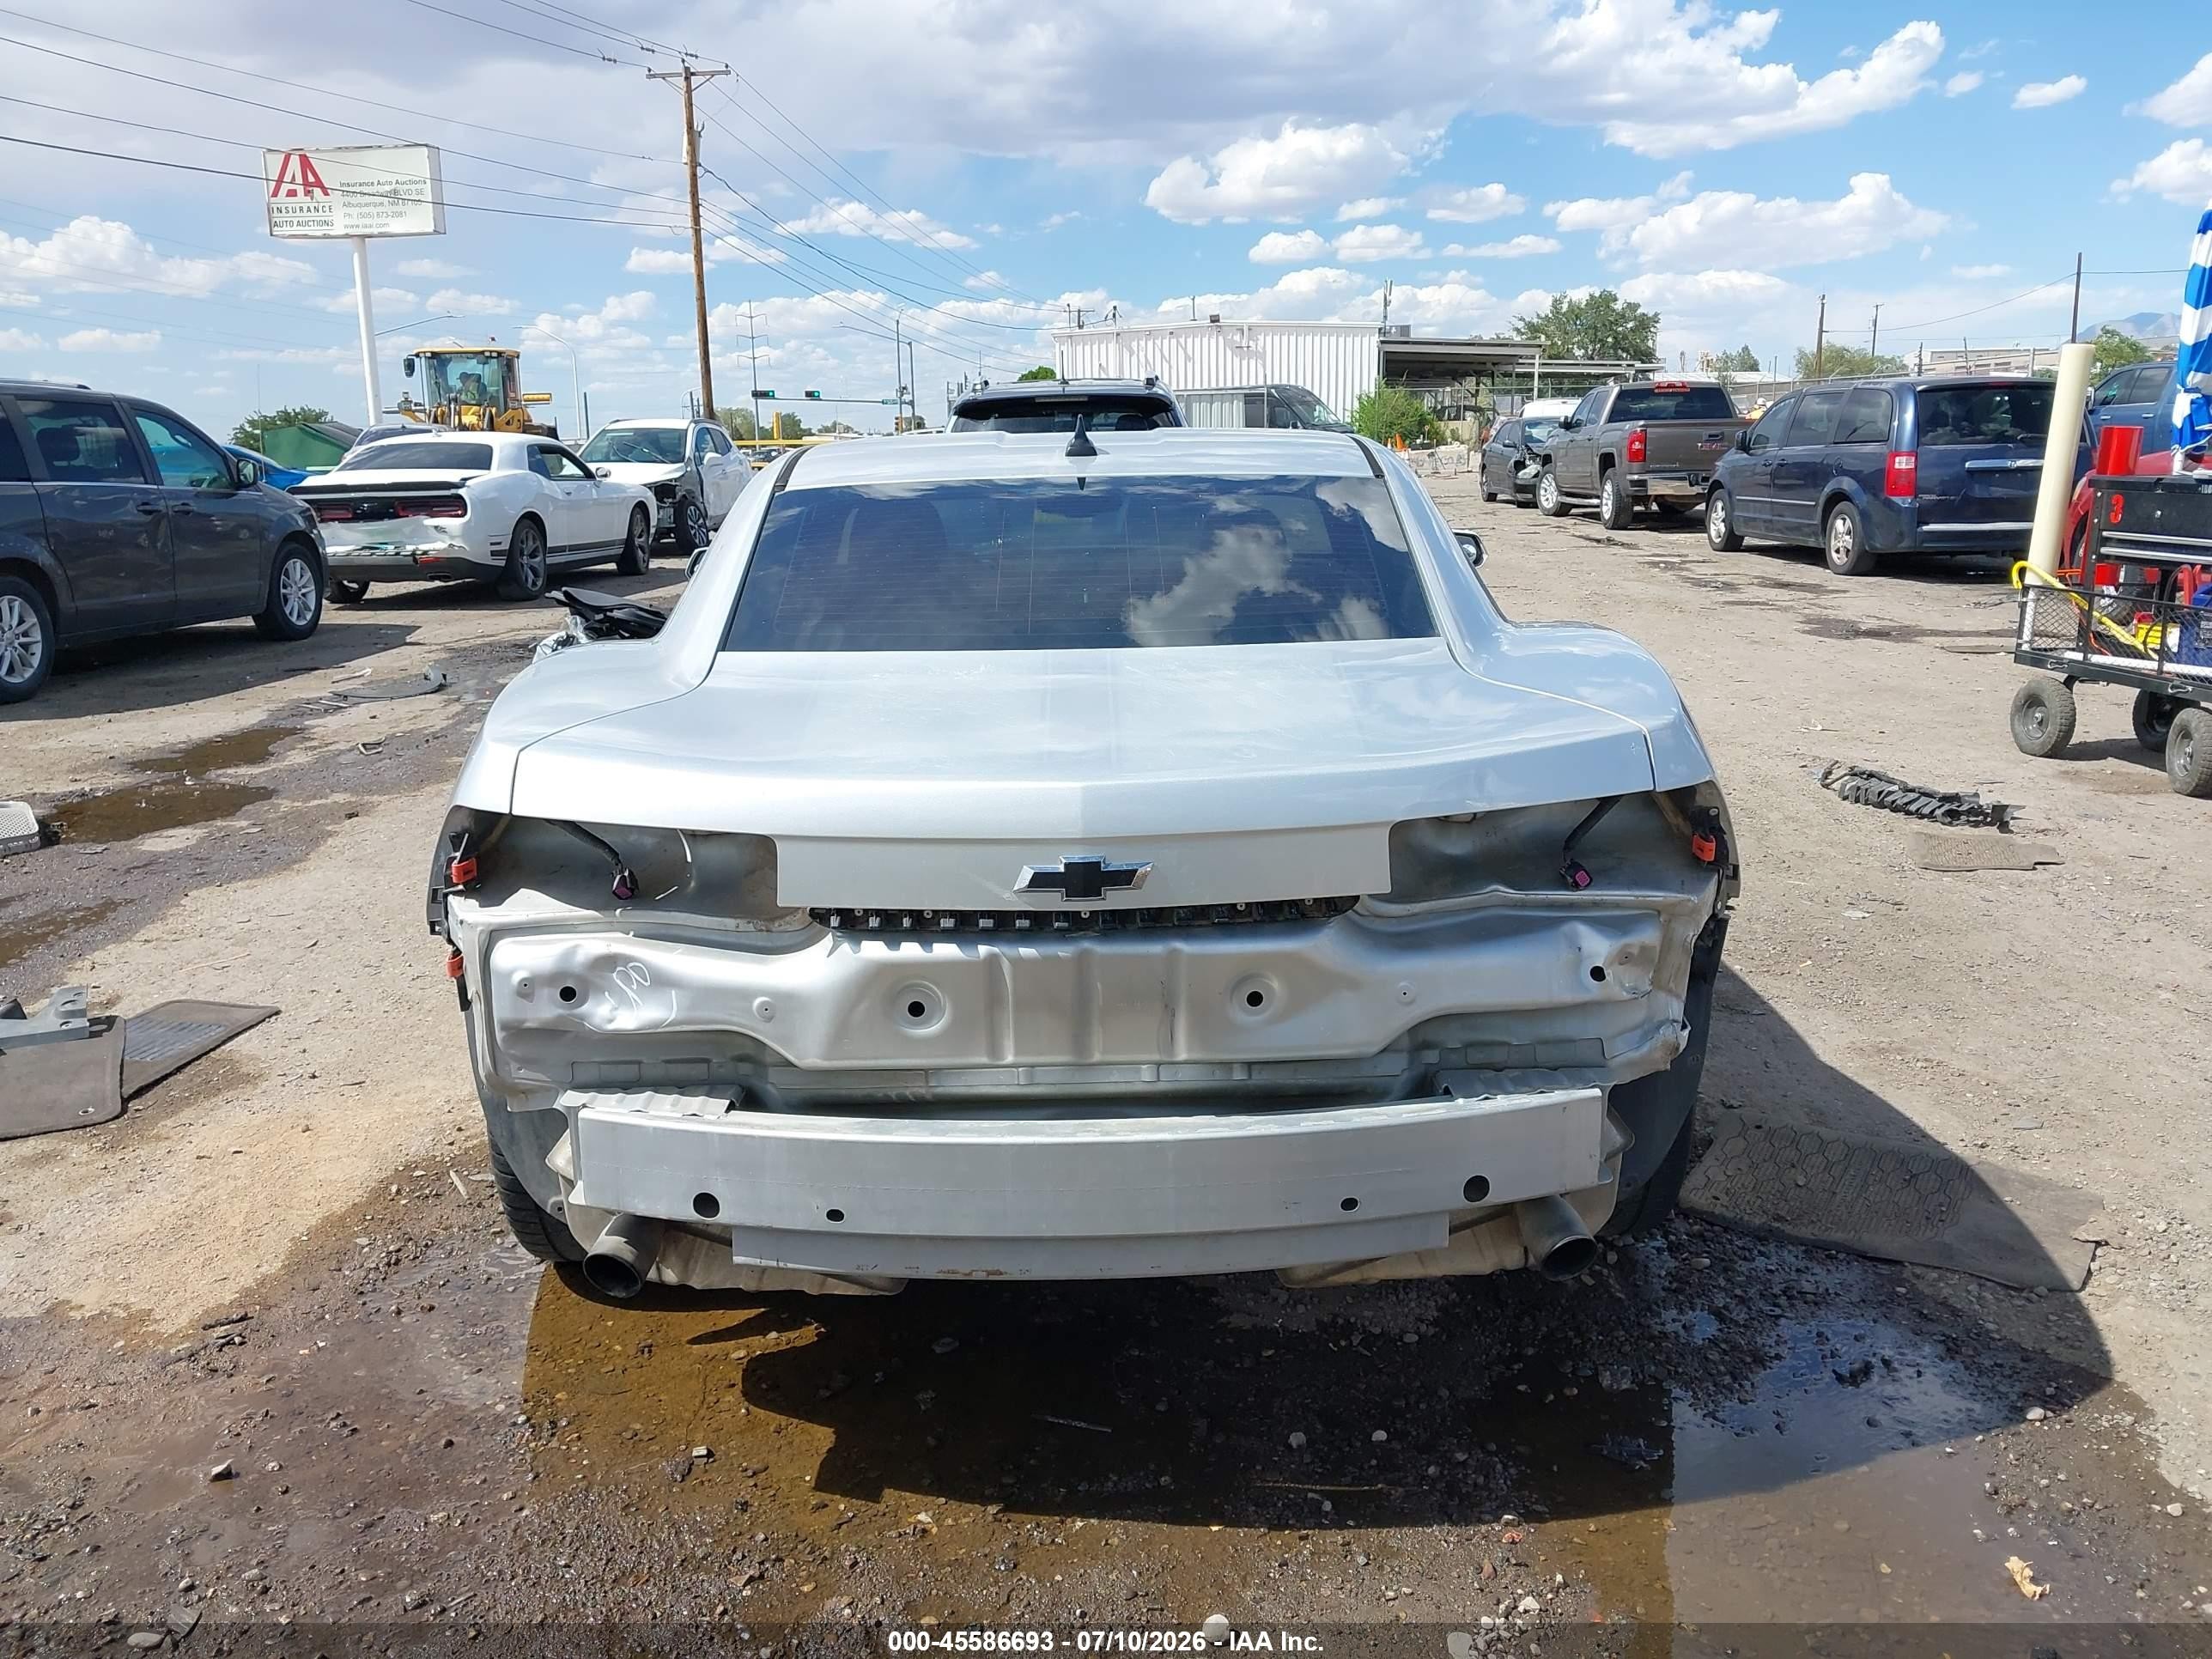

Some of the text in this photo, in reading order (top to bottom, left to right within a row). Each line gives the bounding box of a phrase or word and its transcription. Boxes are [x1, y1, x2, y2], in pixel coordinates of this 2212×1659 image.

[271, 205, 333, 214] INSURANCE
[356, 211, 375, 220] (505)
[273, 219, 334, 228] AUTO AUCTIONS
[2110, 494, 2124, 524] 3
